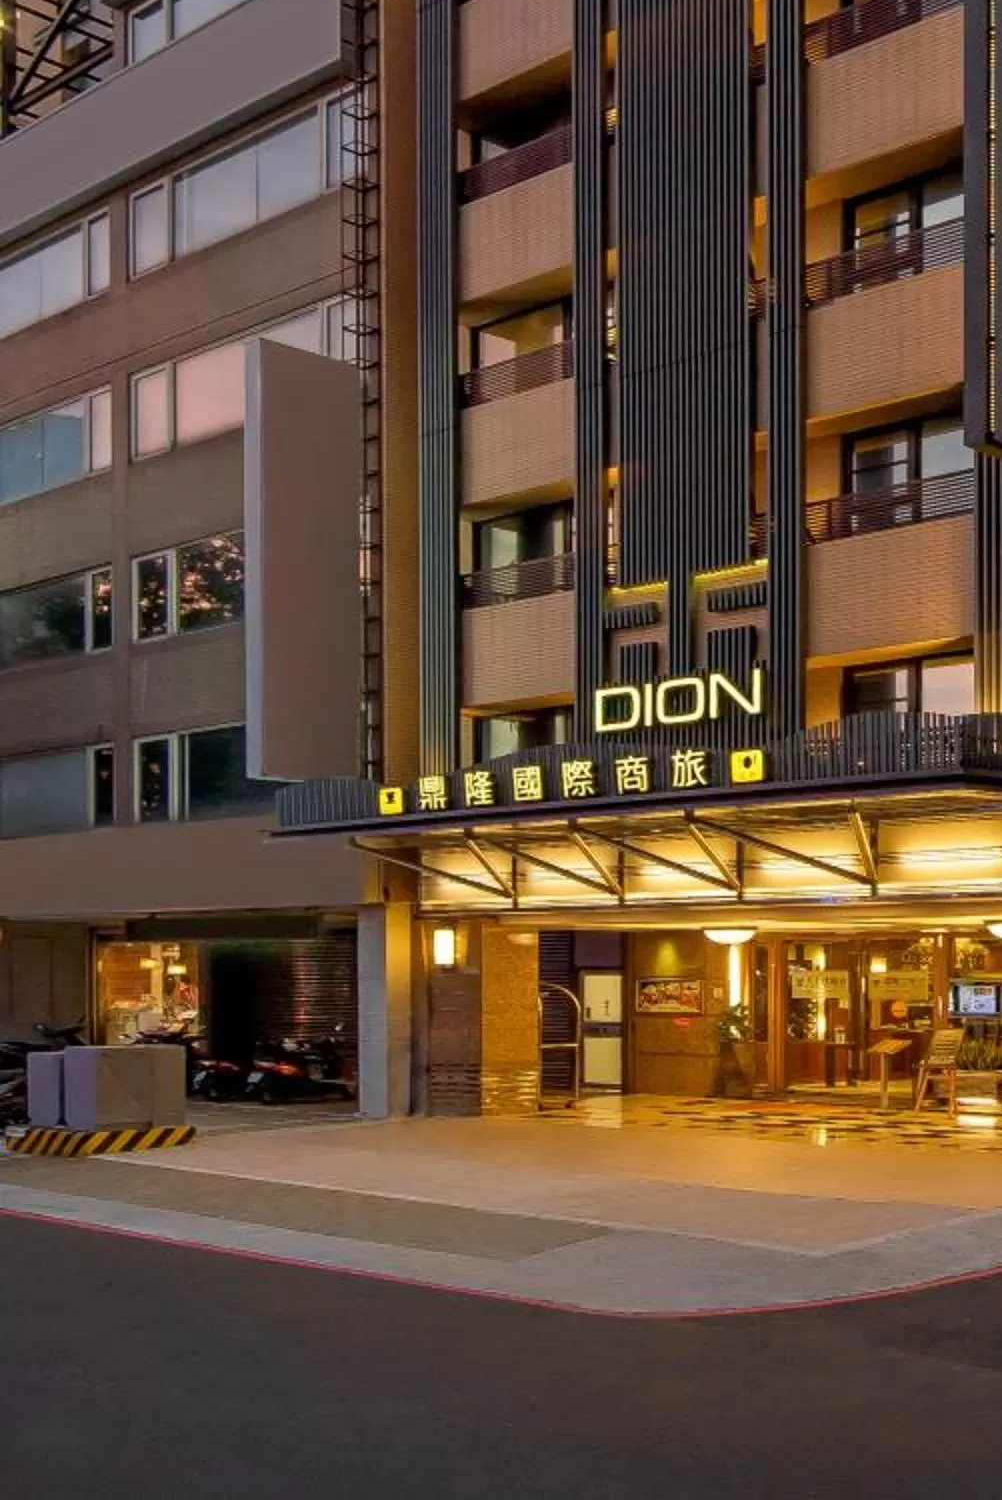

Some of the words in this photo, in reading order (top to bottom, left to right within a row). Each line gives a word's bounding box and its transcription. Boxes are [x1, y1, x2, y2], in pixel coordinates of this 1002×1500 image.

[594, 667, 764, 733] DION
[418, 747, 708, 812] 鼎隆國際商旅
